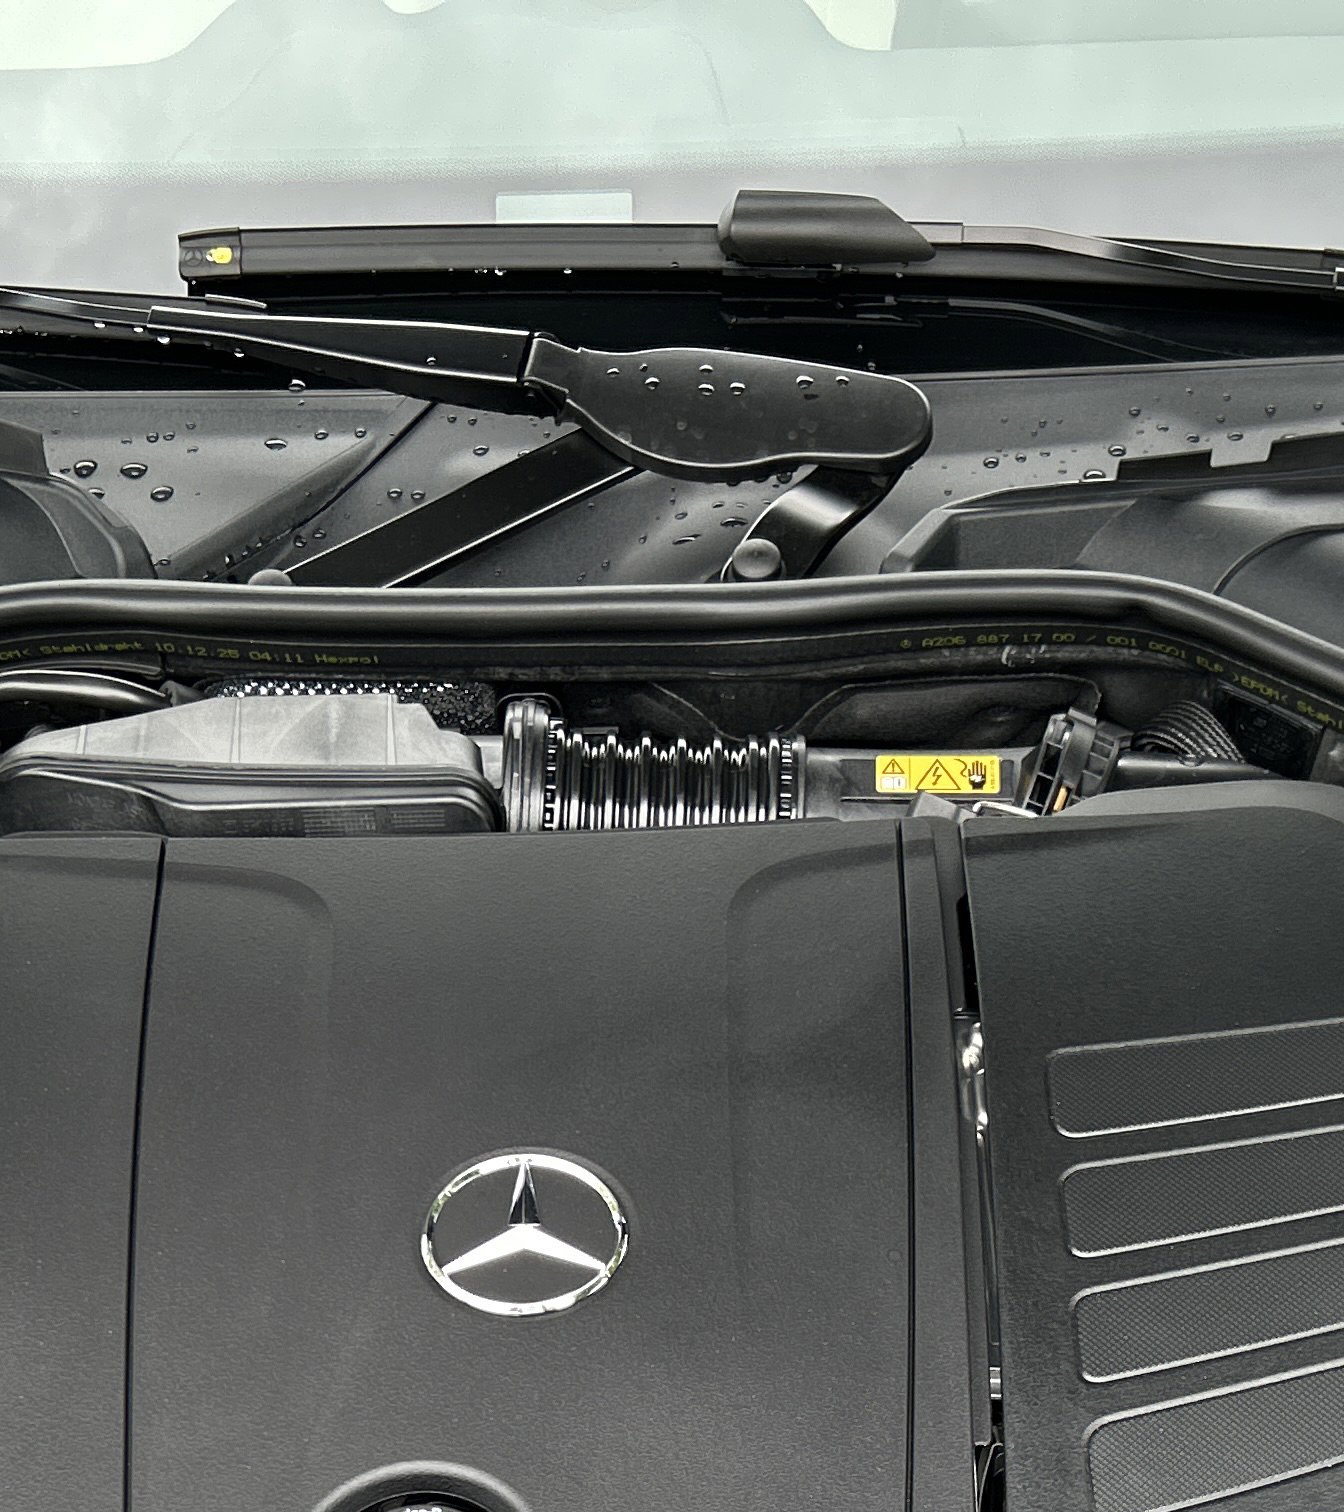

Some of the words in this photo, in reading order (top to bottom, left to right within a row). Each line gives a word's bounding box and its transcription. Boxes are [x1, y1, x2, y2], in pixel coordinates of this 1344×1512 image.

[922, 636, 966, 648] A206
[976, 634, 1010, 645] 887
[1023, 633, 1042, 643] 17
[1052, 633, 1076, 642] 00
[1106, 635, 1138, 647] 001
